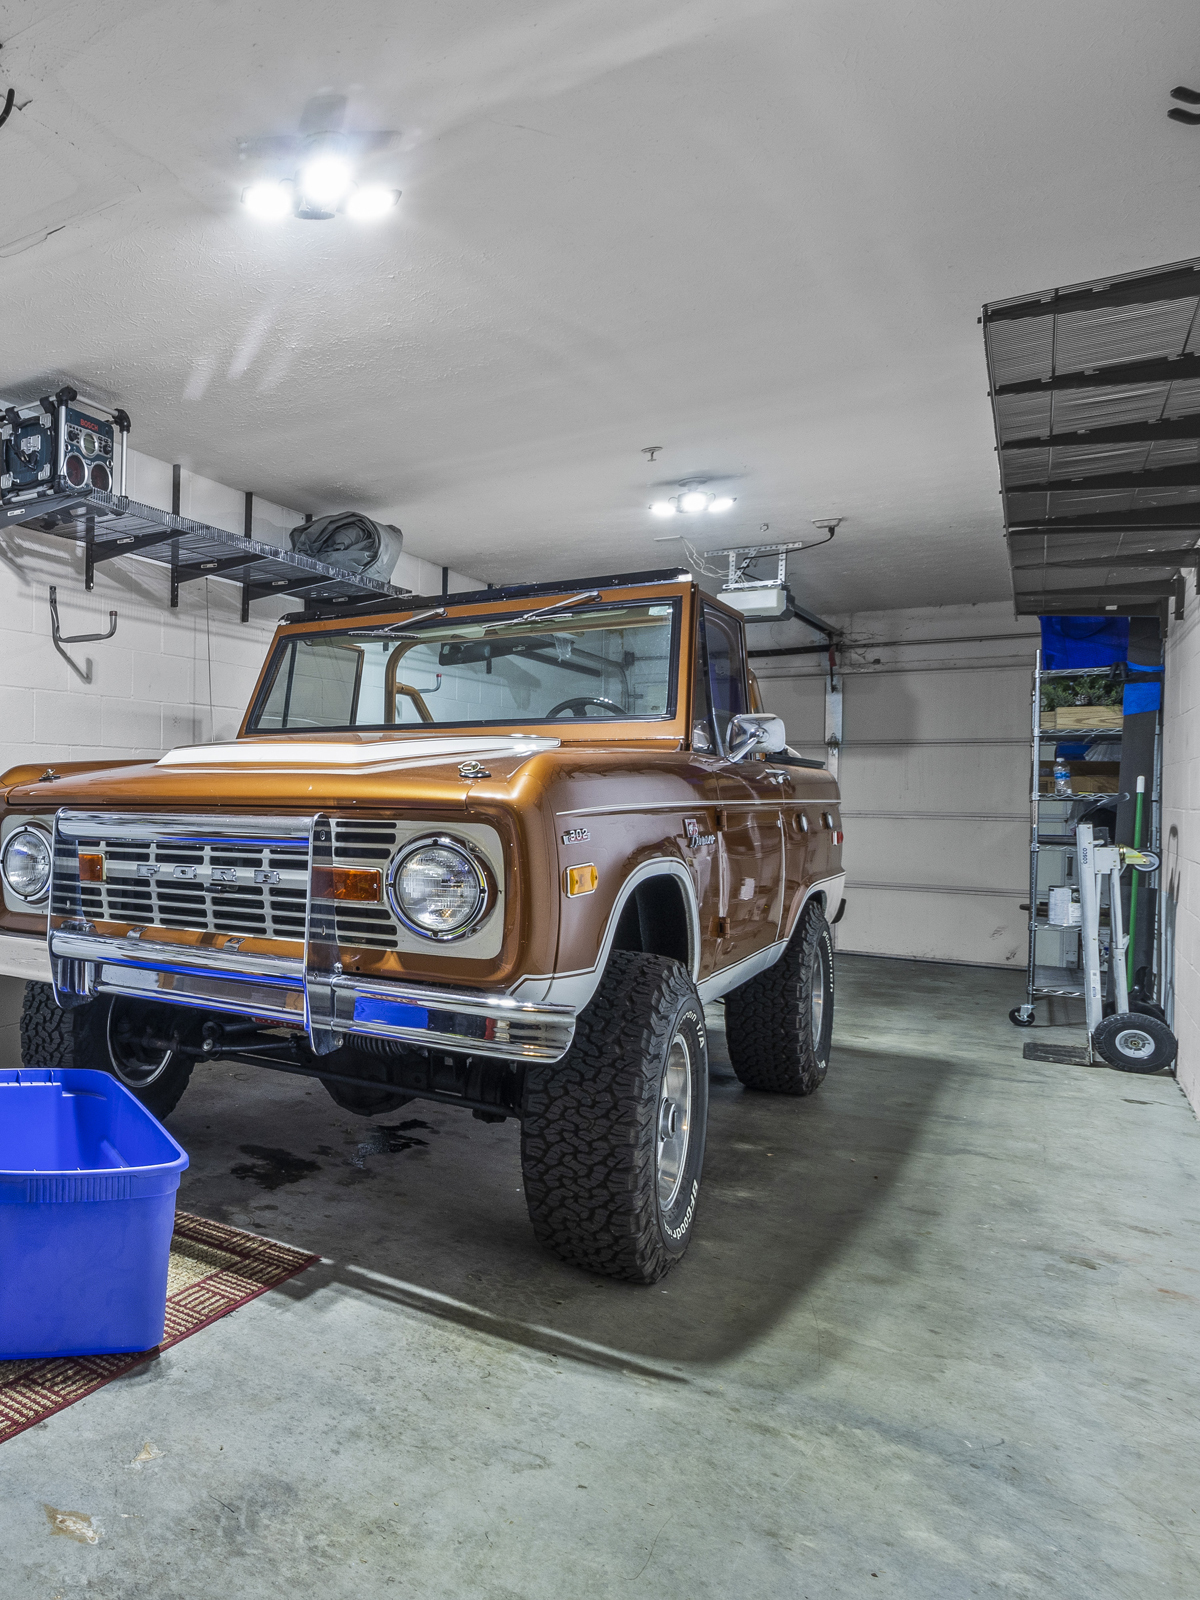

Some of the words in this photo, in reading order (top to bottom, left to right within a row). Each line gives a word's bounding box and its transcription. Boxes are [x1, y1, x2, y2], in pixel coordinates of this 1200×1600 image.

[80, 418, 99, 432] BOSCH
[569, 828, 589, 841] 302
[136, 863, 282, 885] FORD
